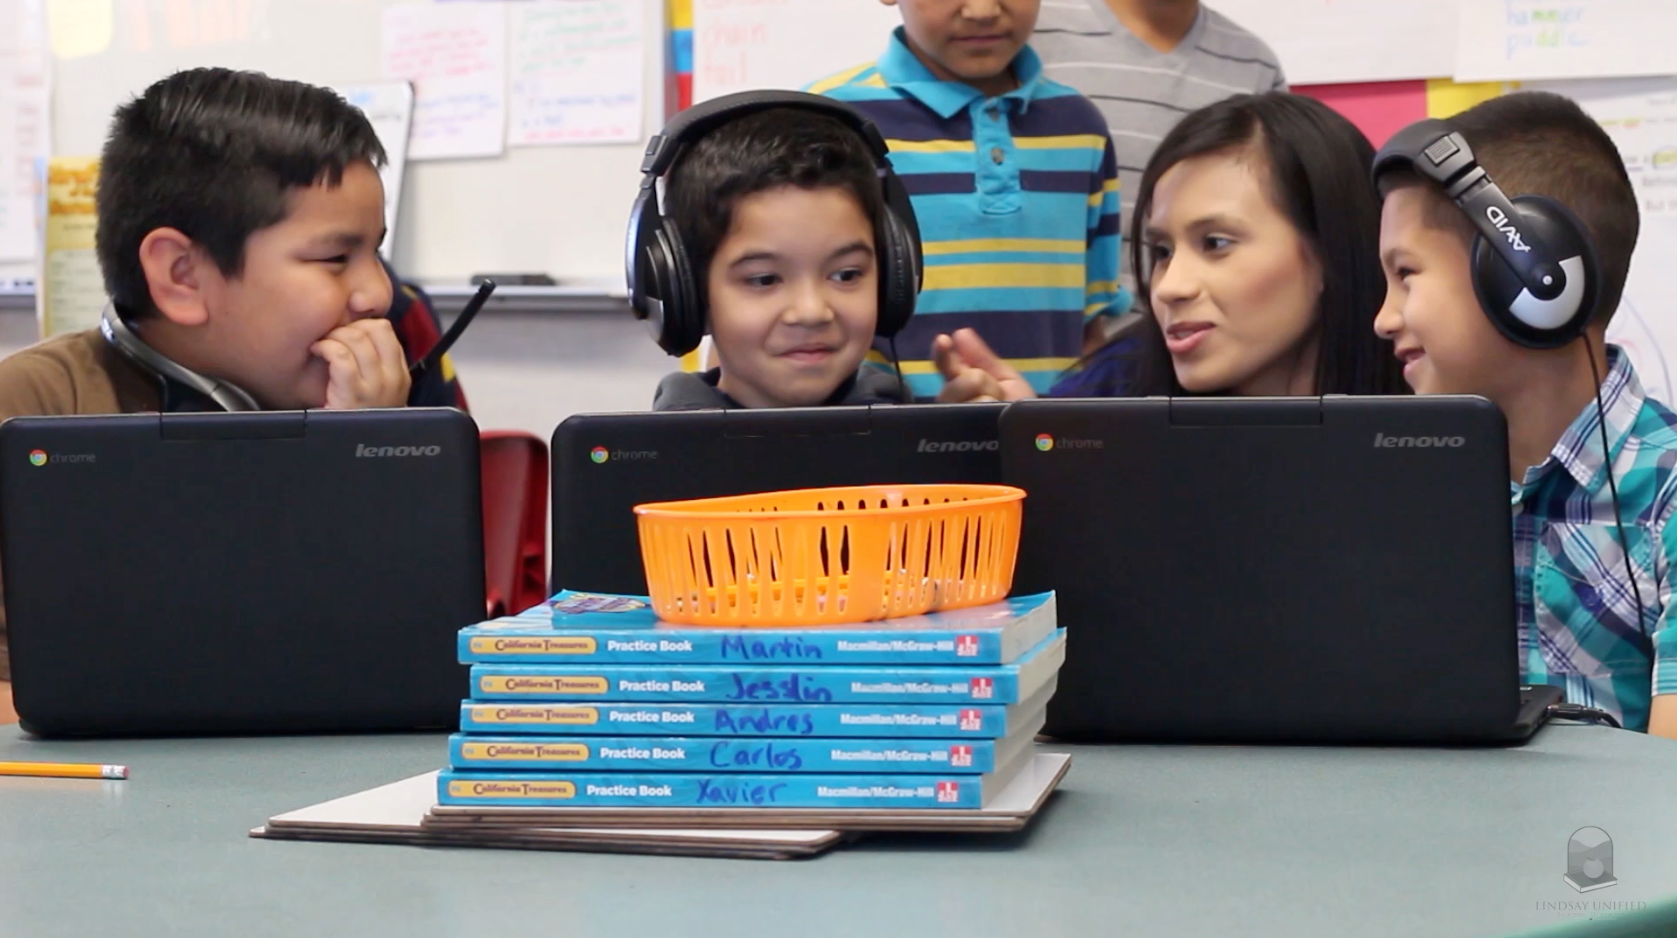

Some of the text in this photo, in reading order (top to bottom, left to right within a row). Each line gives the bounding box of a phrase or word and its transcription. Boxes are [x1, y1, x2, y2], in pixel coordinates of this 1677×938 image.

[1486, 206, 1531, 252] AVID
[917, 438, 999, 453] lenovo
[1056, 437, 1105, 449] chrome
[1373, 432, 1466, 448] lenovo
[355, 443, 441, 458] lenovo
[611, 448, 659, 461] chrome
[50, 451, 97, 463] chrome
[495, 639, 541, 651] California
[543, 640, 588, 651] Treasures
[607, 640, 692, 651] Practice Book
[721, 634, 822, 660] Martin
[837, 640, 954, 651] Macmillan/McGraw-Hill
[505, 678, 553, 690] California
[554, 679, 600, 691] Treasures
[619, 680, 705, 692] Practice Book
[725, 672, 832, 702] Jesslin
[851, 682, 968, 693] Macmillan/McGraw-Hill
[496, 708, 543, 720] California
[545, 709, 590, 720] Treasures
[609, 711, 694, 723] Practice Book
[840, 713, 957, 725] Macmillan/McGraw-Hill
[715, 707, 814, 735] Andres
[487, 745, 534, 757] California
[535, 746, 580, 757] Treasures
[600, 747, 685, 759] Practice Book
[710, 740, 803, 770] Carlos
[831, 749, 948, 761] Macmillan/McGraw-Hill
[473, 783, 521, 795] California
[521, 784, 567, 795] Treasures
[587, 785, 672, 797] Practice Book
[696, 778, 788, 806] Xavier
[817, 786, 934, 797] Macmillan/McGraw-Hill
